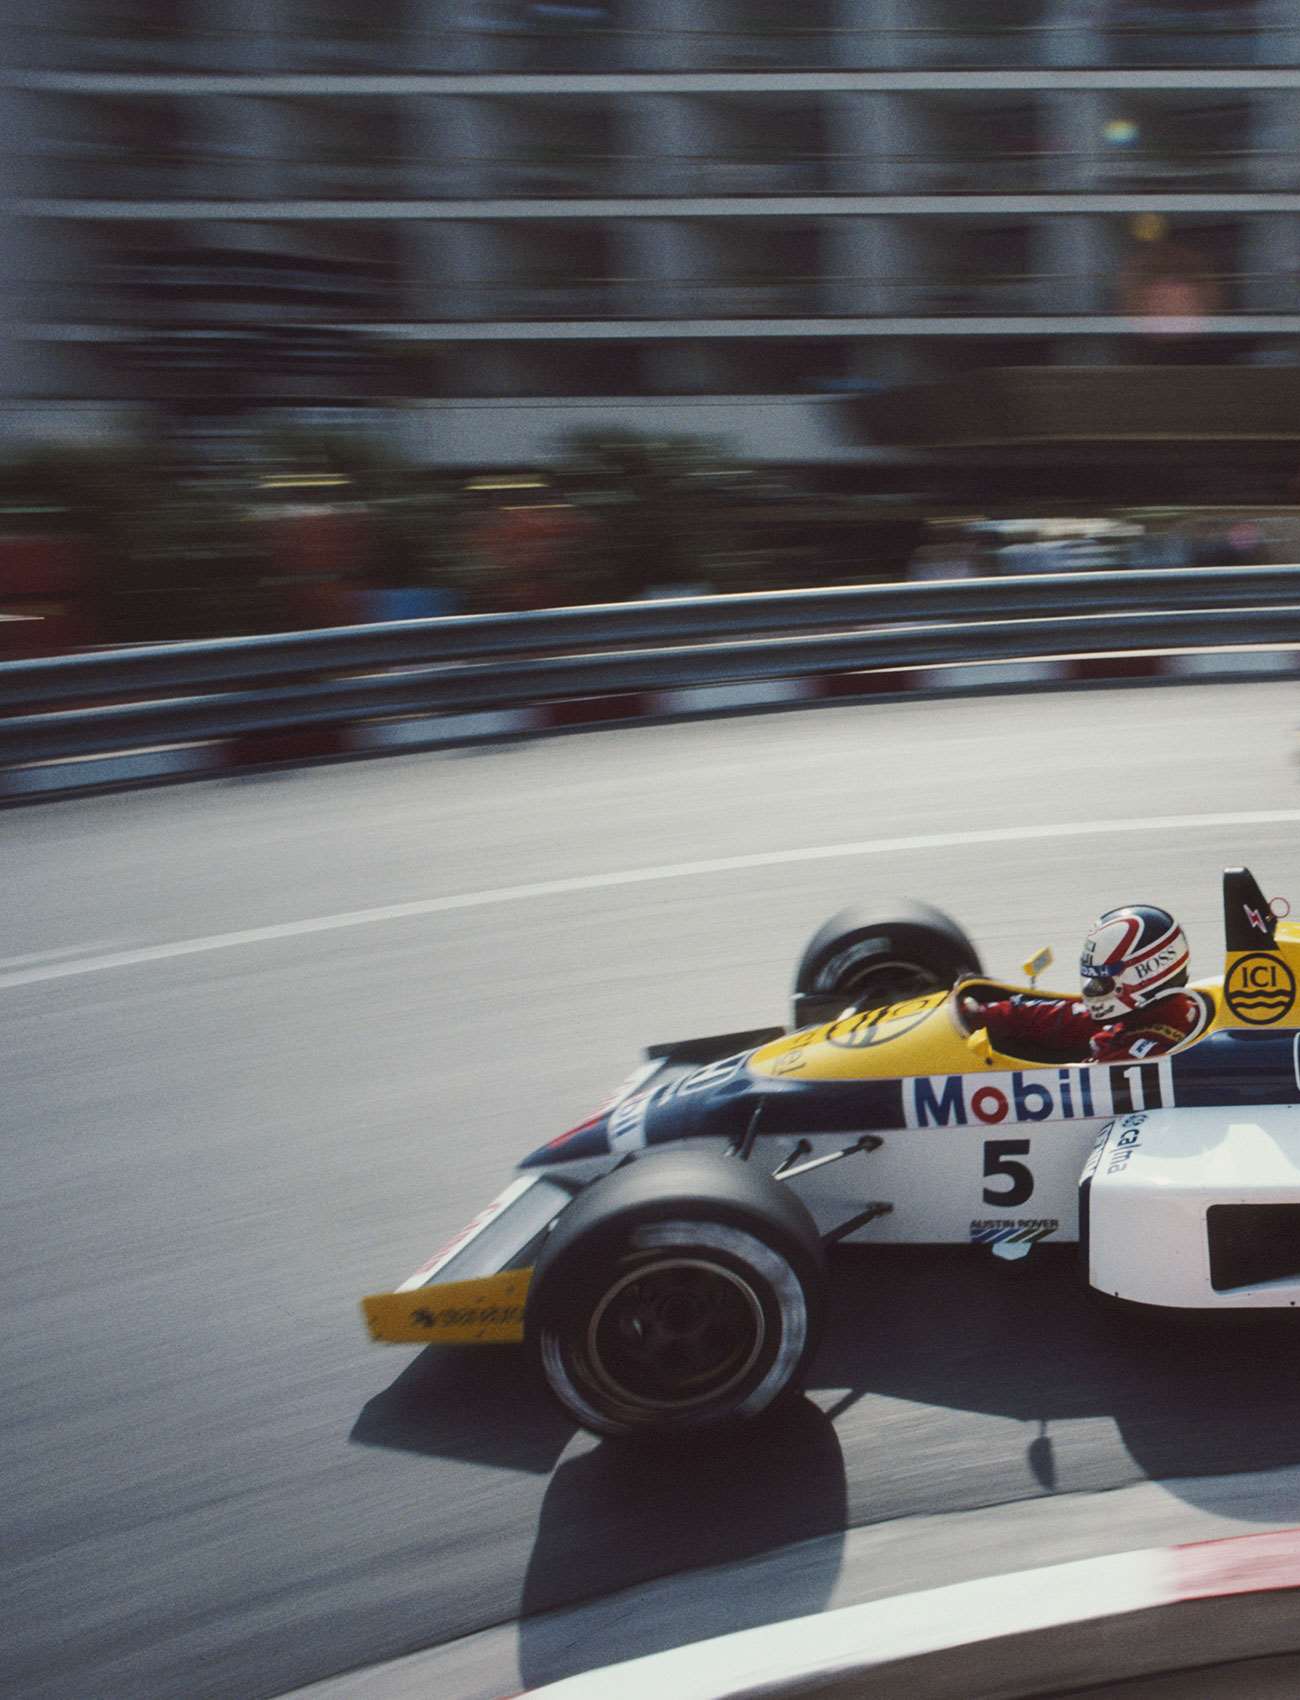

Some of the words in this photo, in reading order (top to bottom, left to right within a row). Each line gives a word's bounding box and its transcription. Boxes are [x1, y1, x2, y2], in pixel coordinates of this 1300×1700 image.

[1135, 945, 1177, 979] BOSS
[1242, 966, 1278, 988] ICI
[914, 1067, 1095, 1125] Mobil
[1124, 1066, 1146, 1111] 1
[982, 1139, 1034, 1207] 5
[970, 1219, 1016, 1230] AUSTIN
